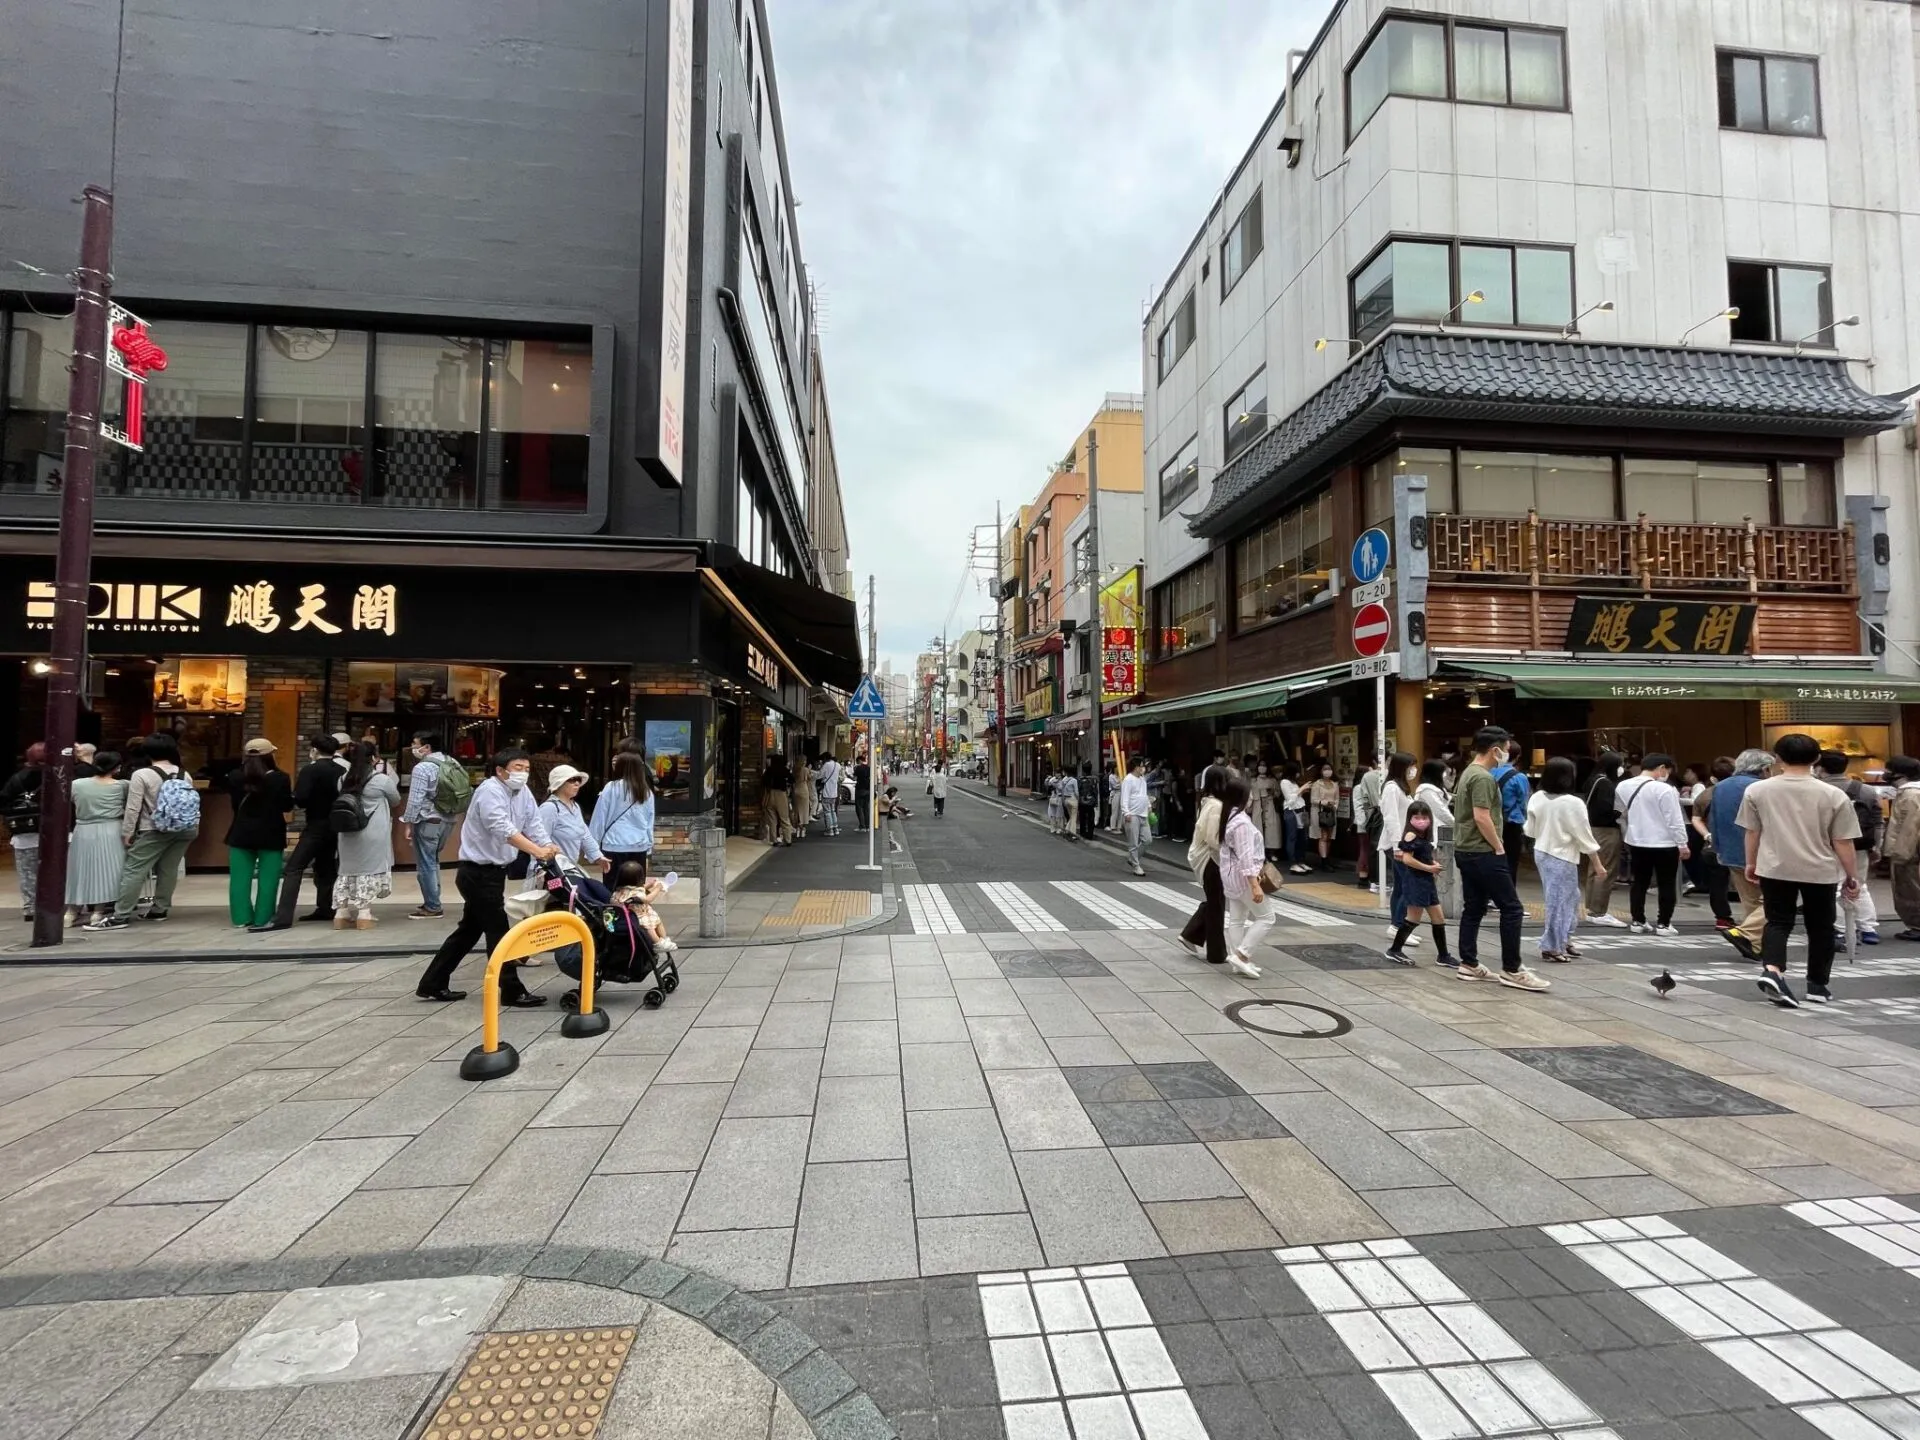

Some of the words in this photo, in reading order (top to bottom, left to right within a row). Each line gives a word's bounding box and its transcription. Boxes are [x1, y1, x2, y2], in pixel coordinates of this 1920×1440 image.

[1356, 583, 1386, 603] 12-20
[226, 580, 397, 636] 鵬天閣
[27, 623, 105, 631] YOKMA
[114, 623, 200, 633] CHINATOWN
[1585, 601, 1740, 654] 鵬天閣
[1610, 686, 1624, 696] 1F
[1627, 685, 1696, 696] おみやげコーナー
